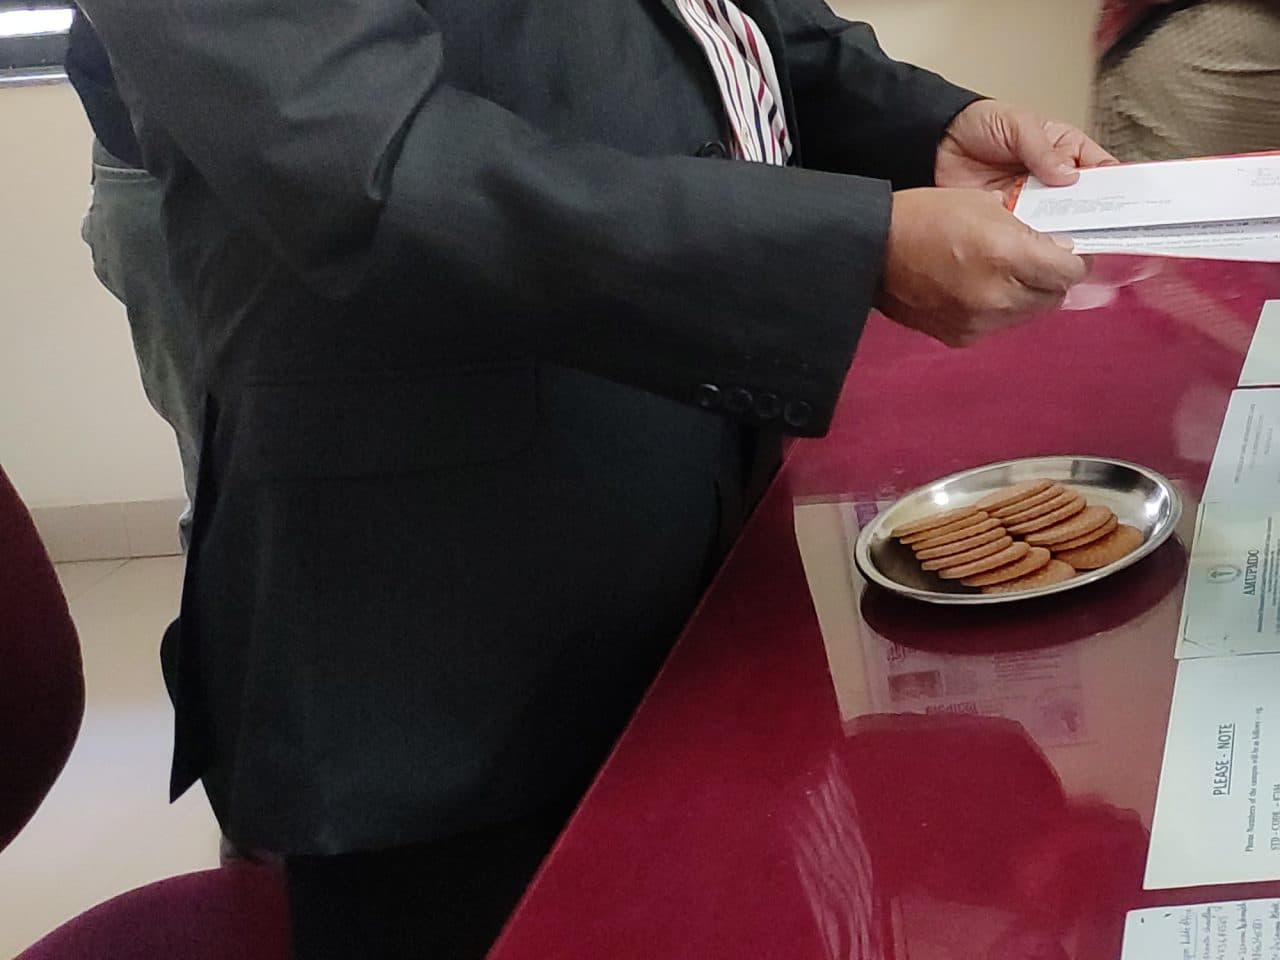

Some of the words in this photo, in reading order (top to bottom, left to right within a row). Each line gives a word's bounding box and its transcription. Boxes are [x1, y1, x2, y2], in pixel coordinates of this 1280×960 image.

[1217, 724, 1232, 749] NOTE
[1213, 760, 1229, 795] PLEASE
[1248, 788, 1256, 796] the
[1246, 805, 1255, 832] Numbers
[1245, 834, 1254, 852] Phone
